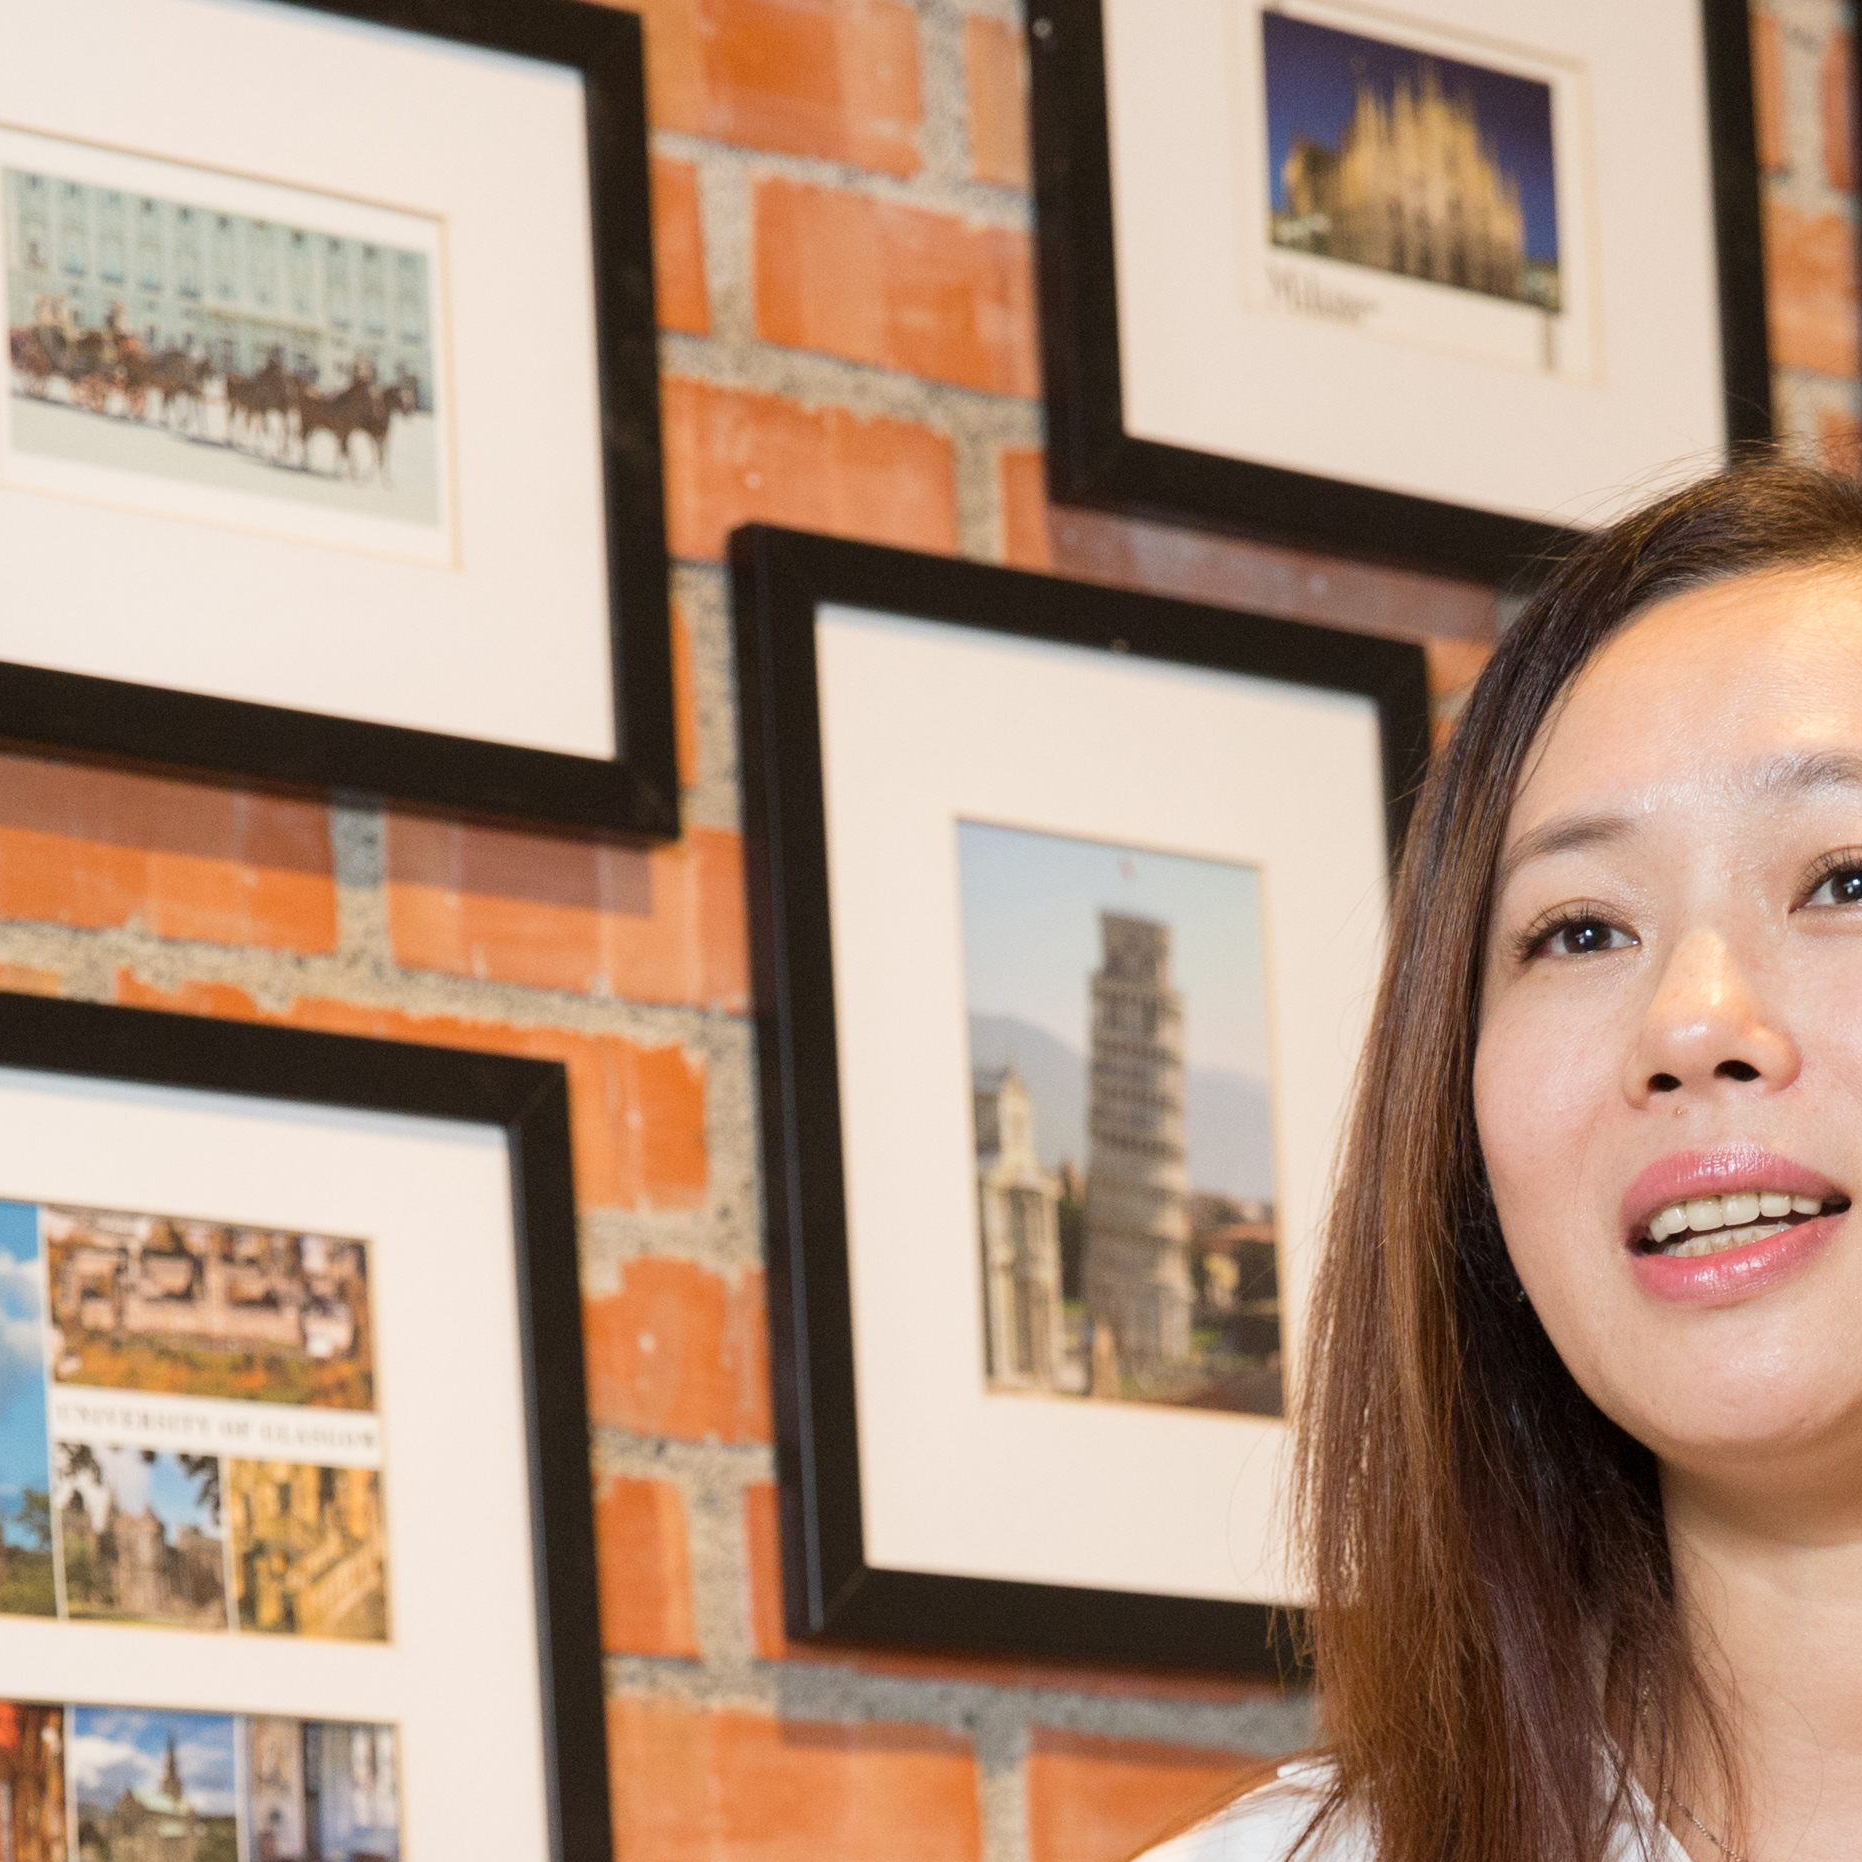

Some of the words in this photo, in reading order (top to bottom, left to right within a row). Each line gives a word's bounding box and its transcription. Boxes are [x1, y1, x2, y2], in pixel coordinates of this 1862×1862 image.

[55, 1403, 211, 1436] UNIVERSITY
[218, 1419, 251, 1439] OF
[258, 1422, 377, 1449] GLASGOW
